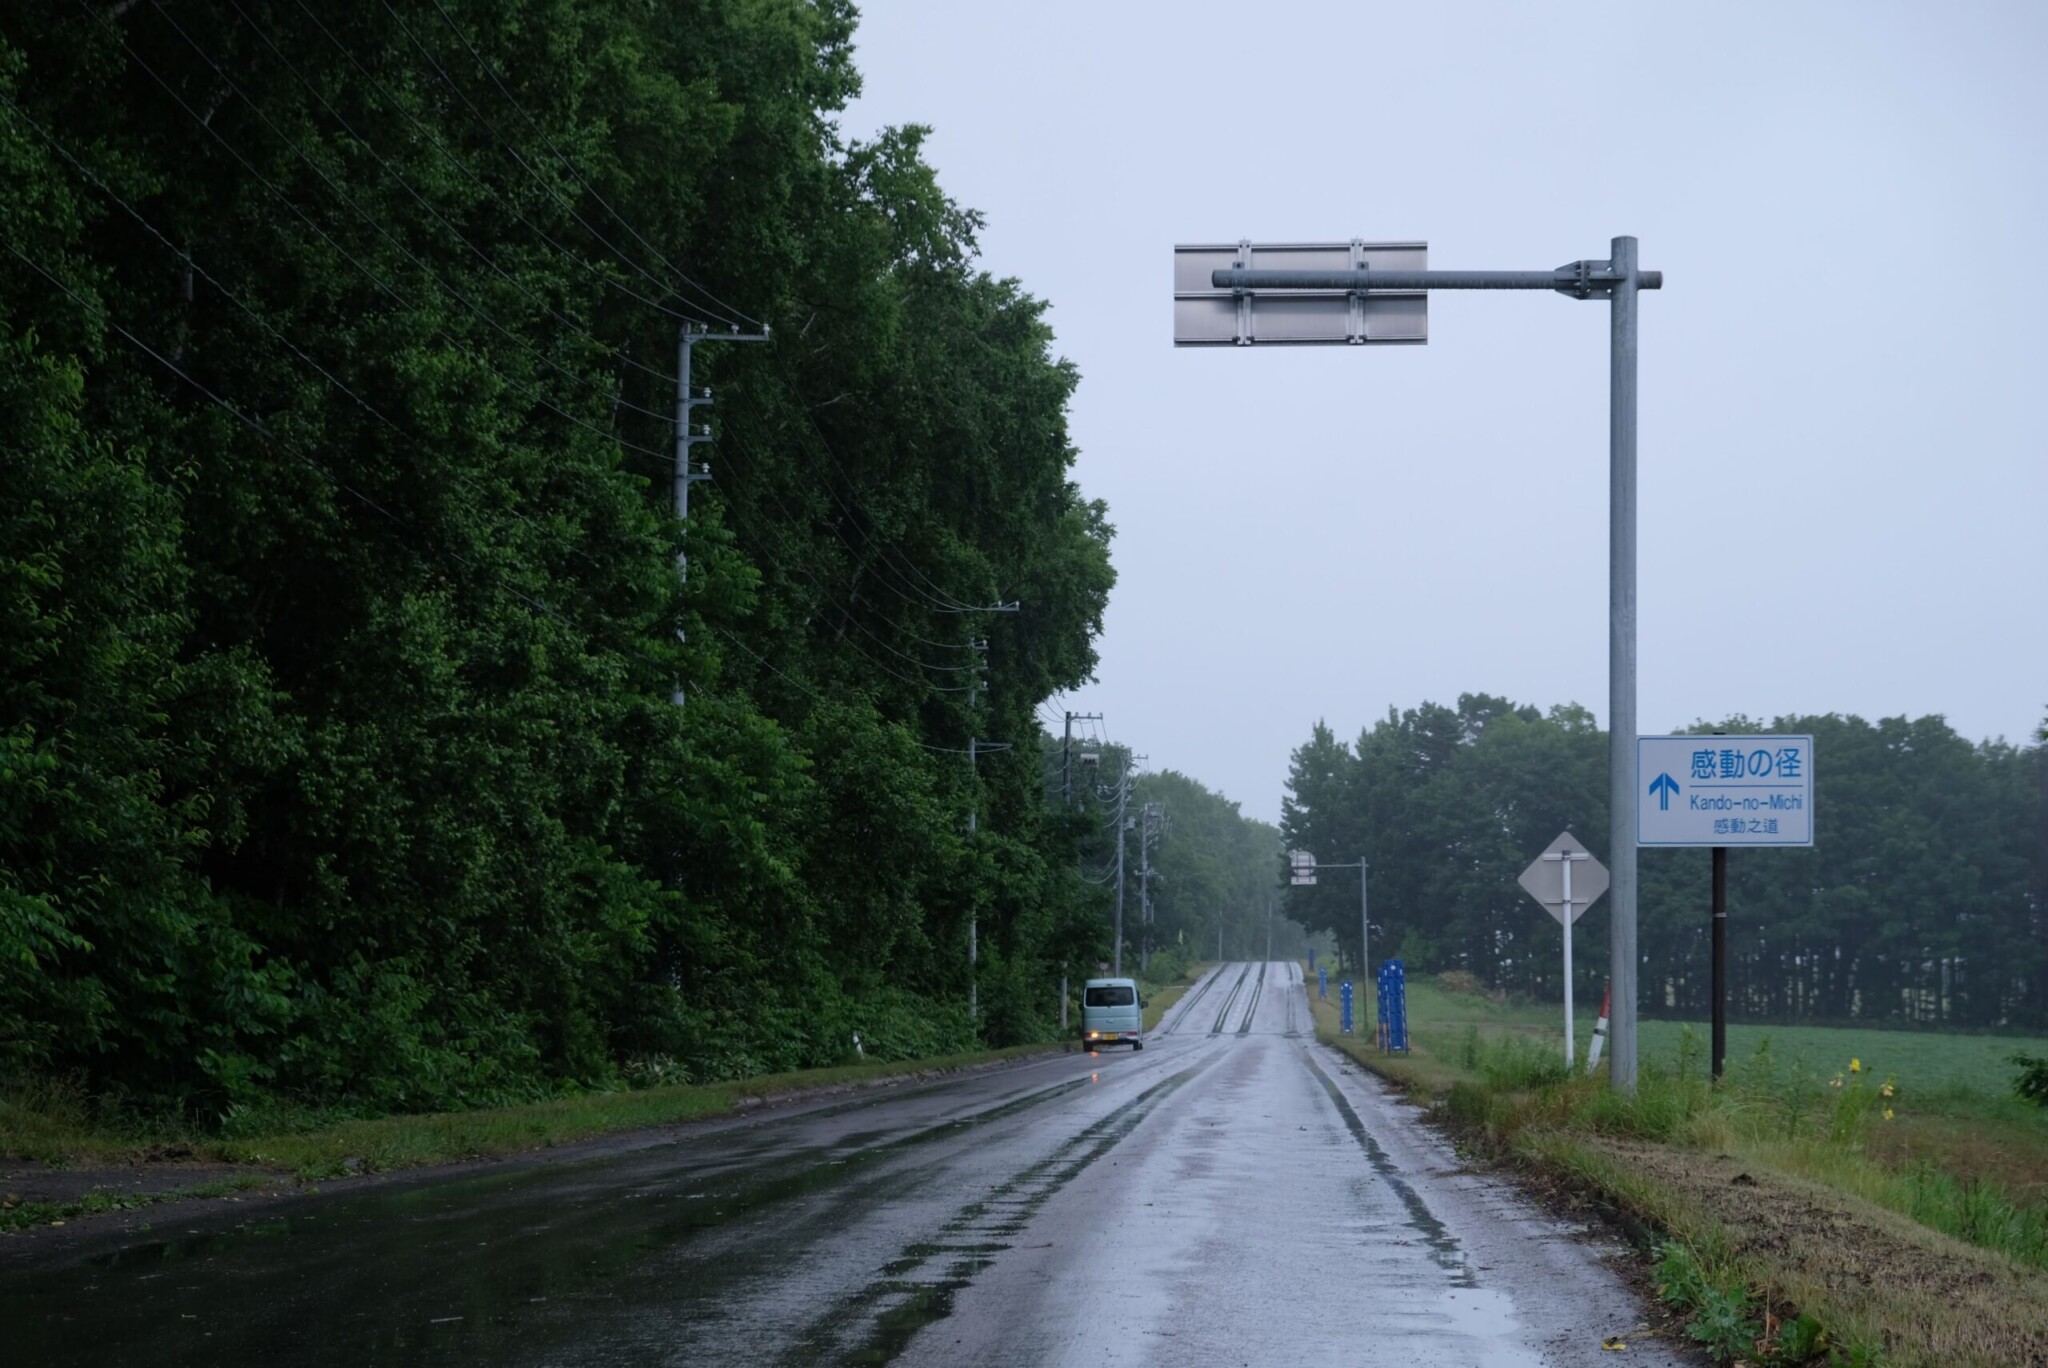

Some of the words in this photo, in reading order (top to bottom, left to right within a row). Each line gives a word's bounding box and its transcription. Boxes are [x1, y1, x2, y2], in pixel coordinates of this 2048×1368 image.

[1691, 748, 1802, 779] 感動の径
[1690, 794, 1802, 810] Kando-no-Michi
[1714, 818, 1778, 834] 感動之道
